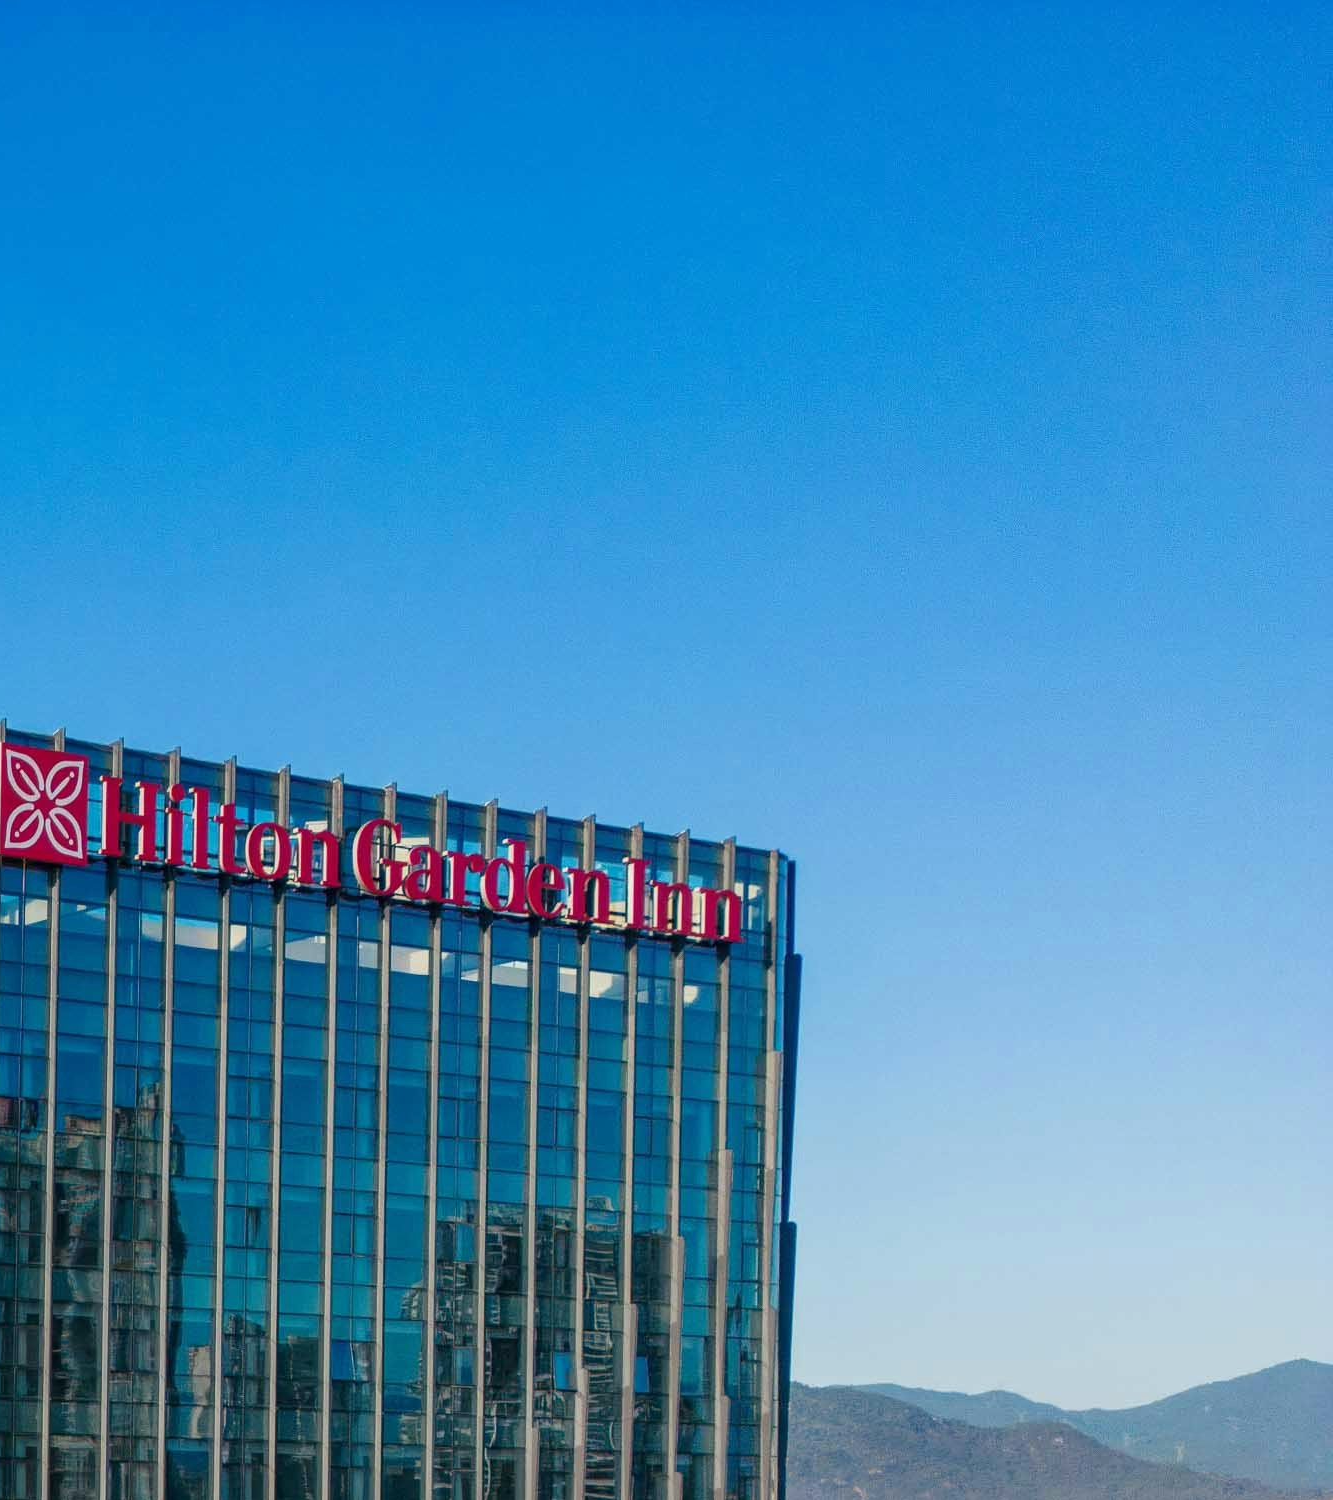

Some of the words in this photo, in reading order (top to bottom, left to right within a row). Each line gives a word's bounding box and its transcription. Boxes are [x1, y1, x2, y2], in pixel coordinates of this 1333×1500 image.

[99, 776, 342, 889] Hilton
[352, 819, 614, 925] Garden
[623, 856, 744, 943] Inn
